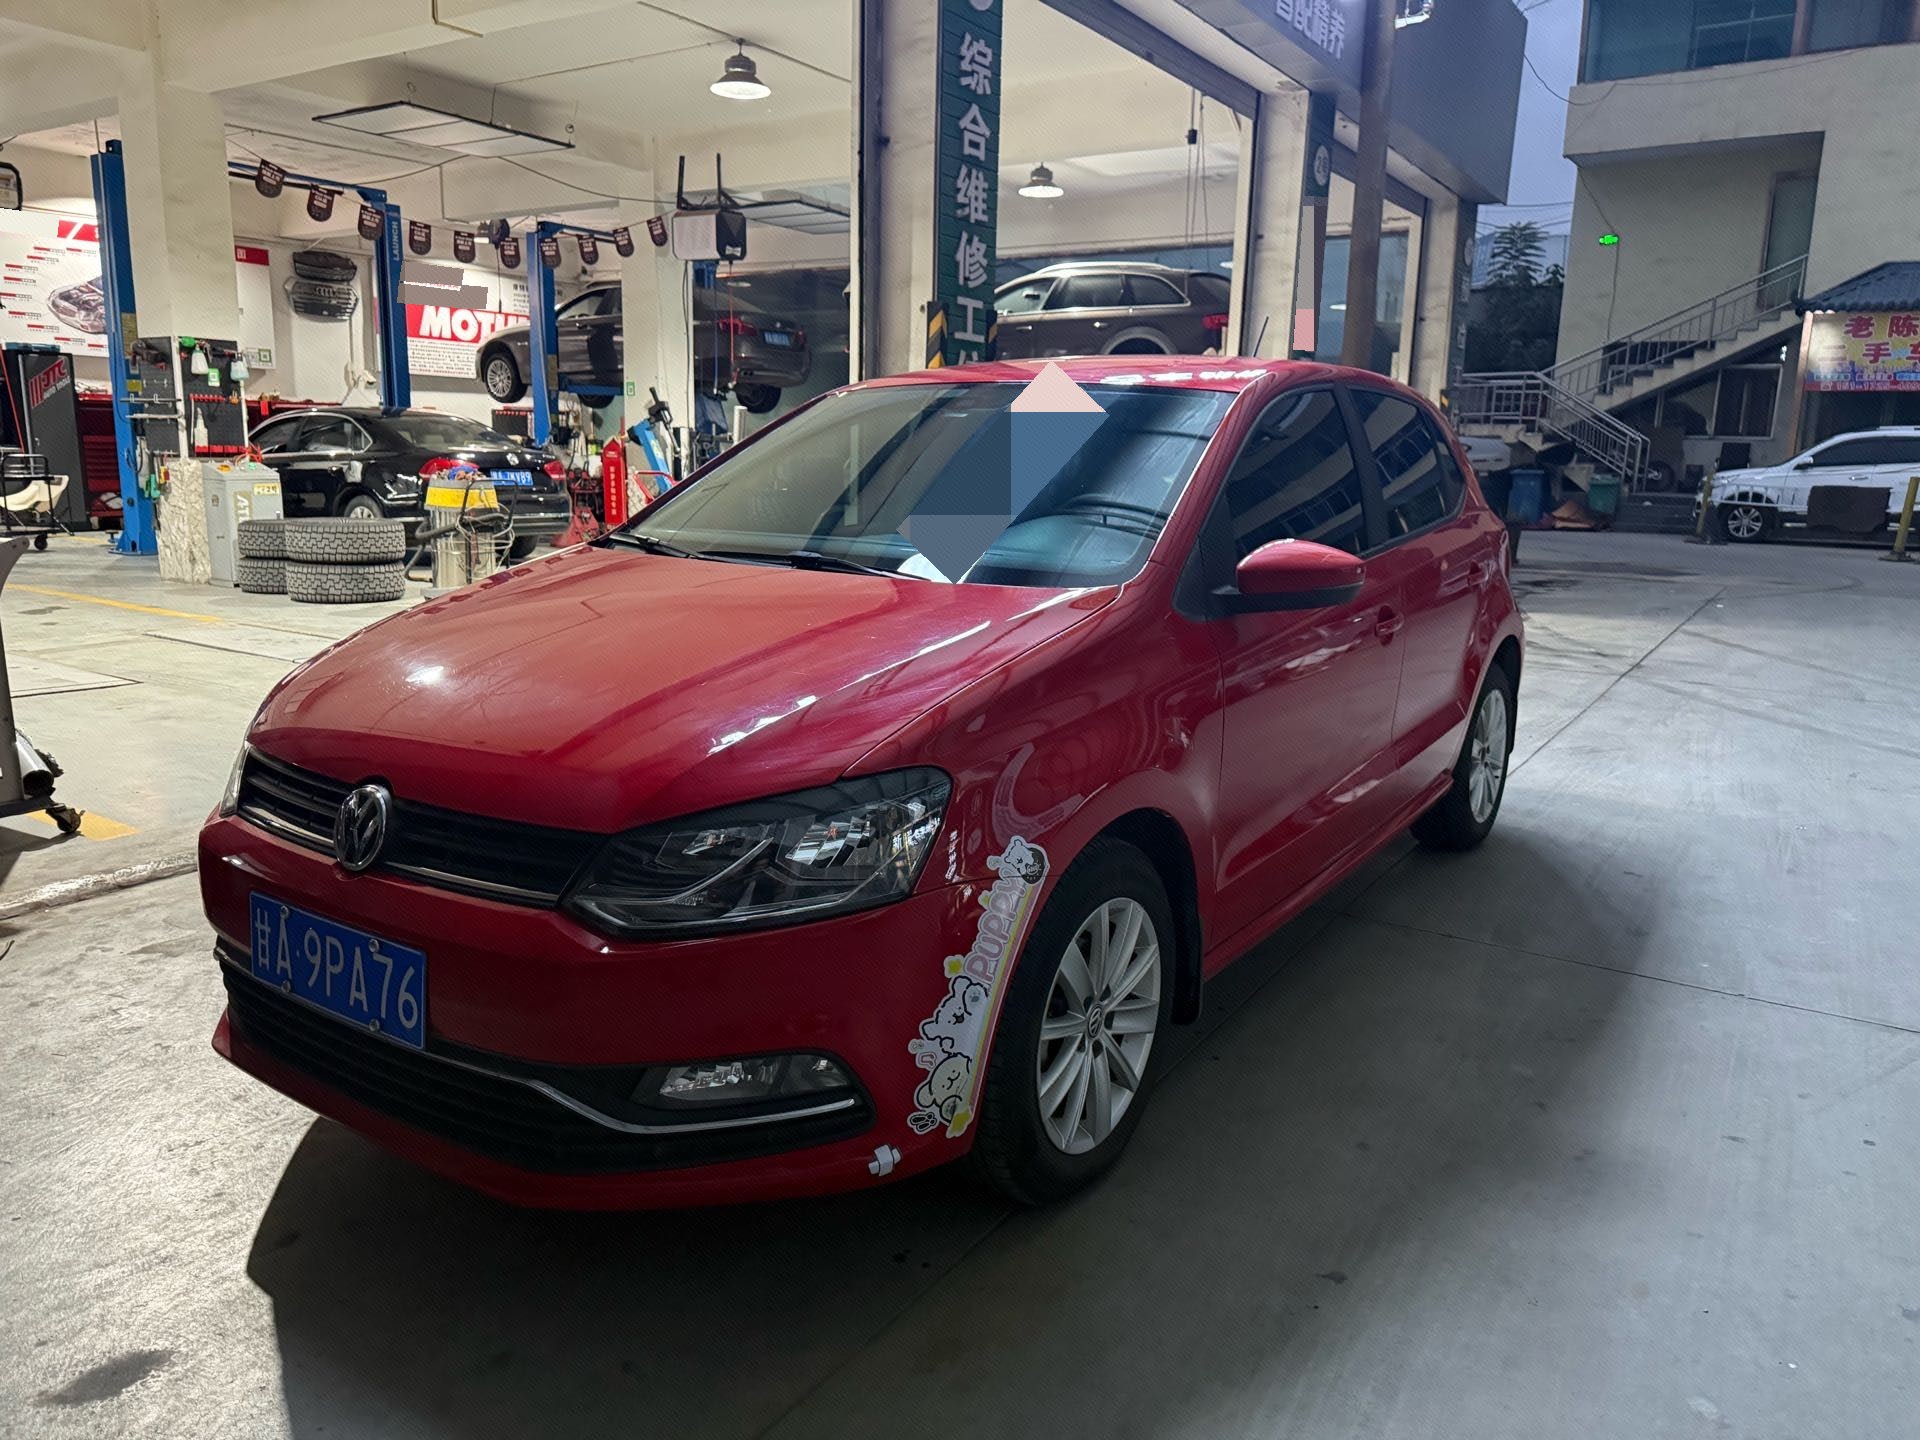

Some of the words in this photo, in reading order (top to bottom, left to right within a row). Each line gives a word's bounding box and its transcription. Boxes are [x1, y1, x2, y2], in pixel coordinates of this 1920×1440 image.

[391, 221, 400, 261] LAUNCH
[954, 33, 992, 364] 综合维修工
